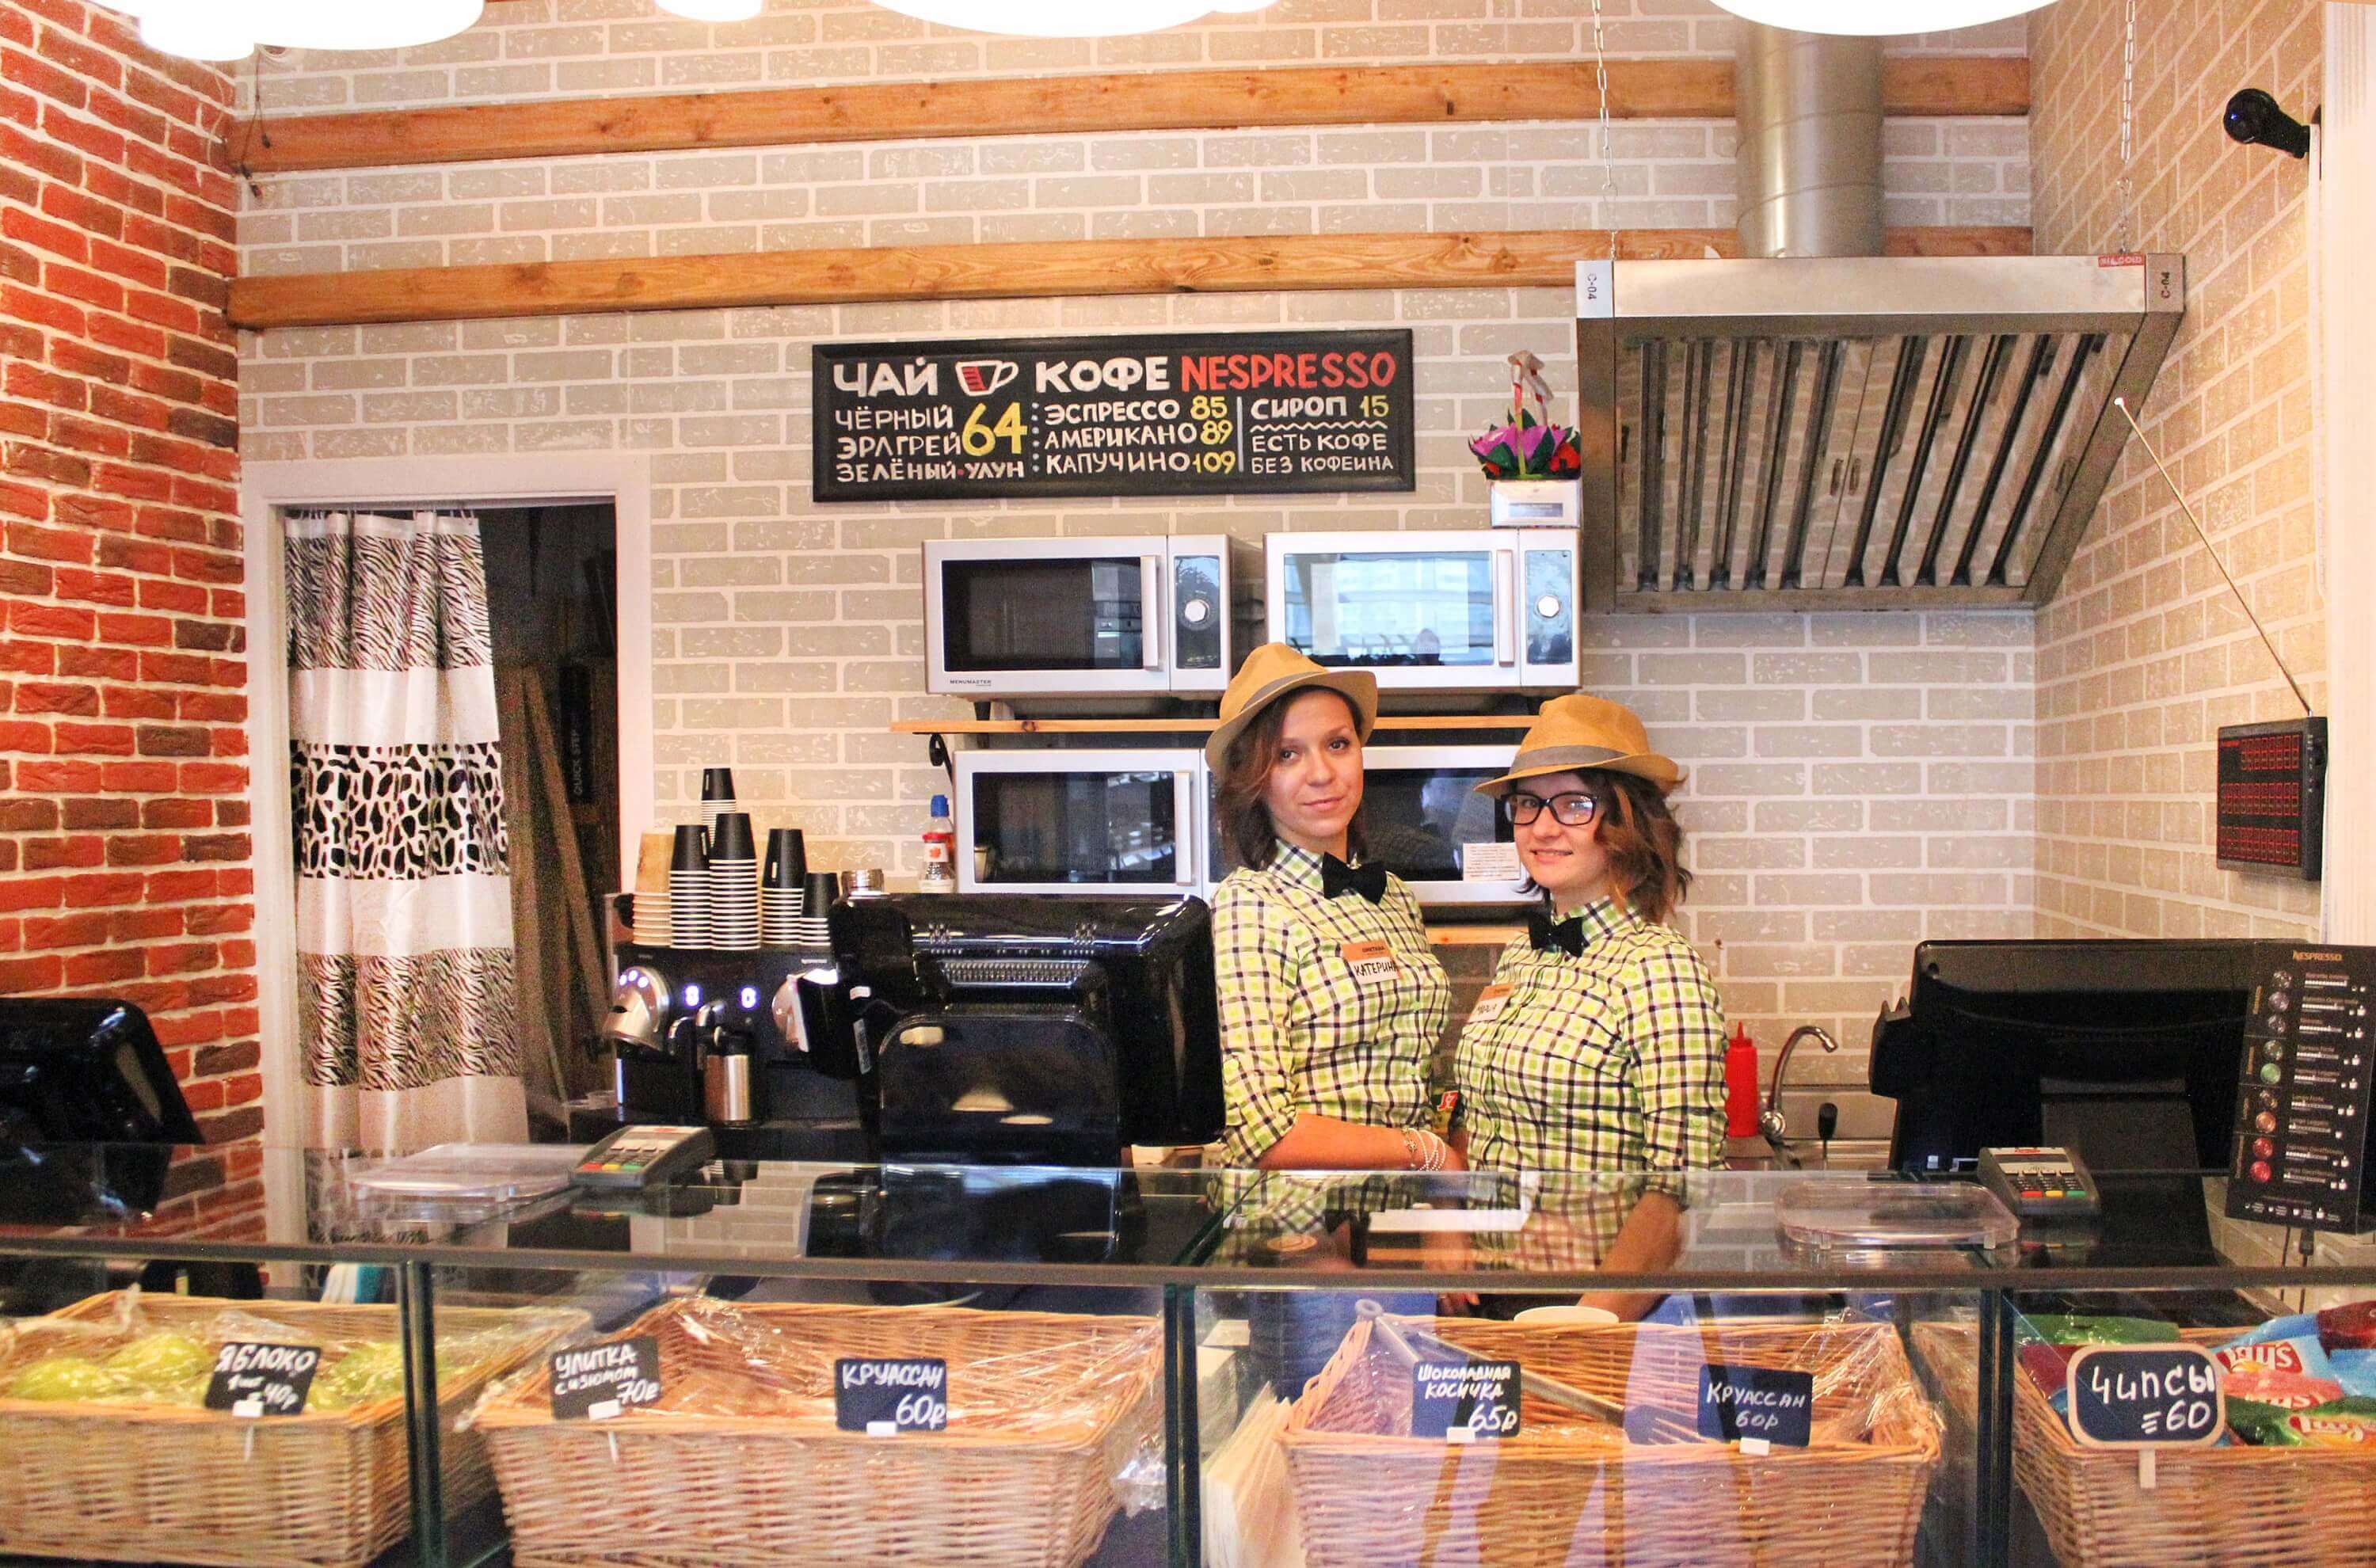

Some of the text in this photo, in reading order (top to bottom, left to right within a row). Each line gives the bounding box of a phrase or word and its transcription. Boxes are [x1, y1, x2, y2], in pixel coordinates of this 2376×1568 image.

[1587, 273, 1597, 300] C-04
[833, 351, 1397, 398] ЧАЙ КОФЕ NESPRESSO
[836, 404, 954, 432] ЧЁРНЫЙ
[1044, 395, 1228, 425] ЭСПРЕССО 85
[1251, 395, 1389, 420] СИРОП 15
[961, 402, 1028, 456] 64
[1045, 420, 1233, 449] АМЕРИКАНО 89
[1251, 433, 1386, 452] ЕСТЬ КОФЕ
[836, 459, 1024, 483] ЗЕЛЁНЫЙ УЛУН
[1046, 451, 1236, 475] КАПУЧИНО 109
[1251, 455, 1394, 474] БЕЗ КОФЕИНА
[215, 1345, 316, 1372] ЯБЛОКО
[555, 1343, 638, 1379] УЛИТКА
[554, 1382, 568, 1395] с
[843, 1363, 943, 1389] КРУАССАН
[1425, 1382, 1504, 1400] КОСИЧКА
